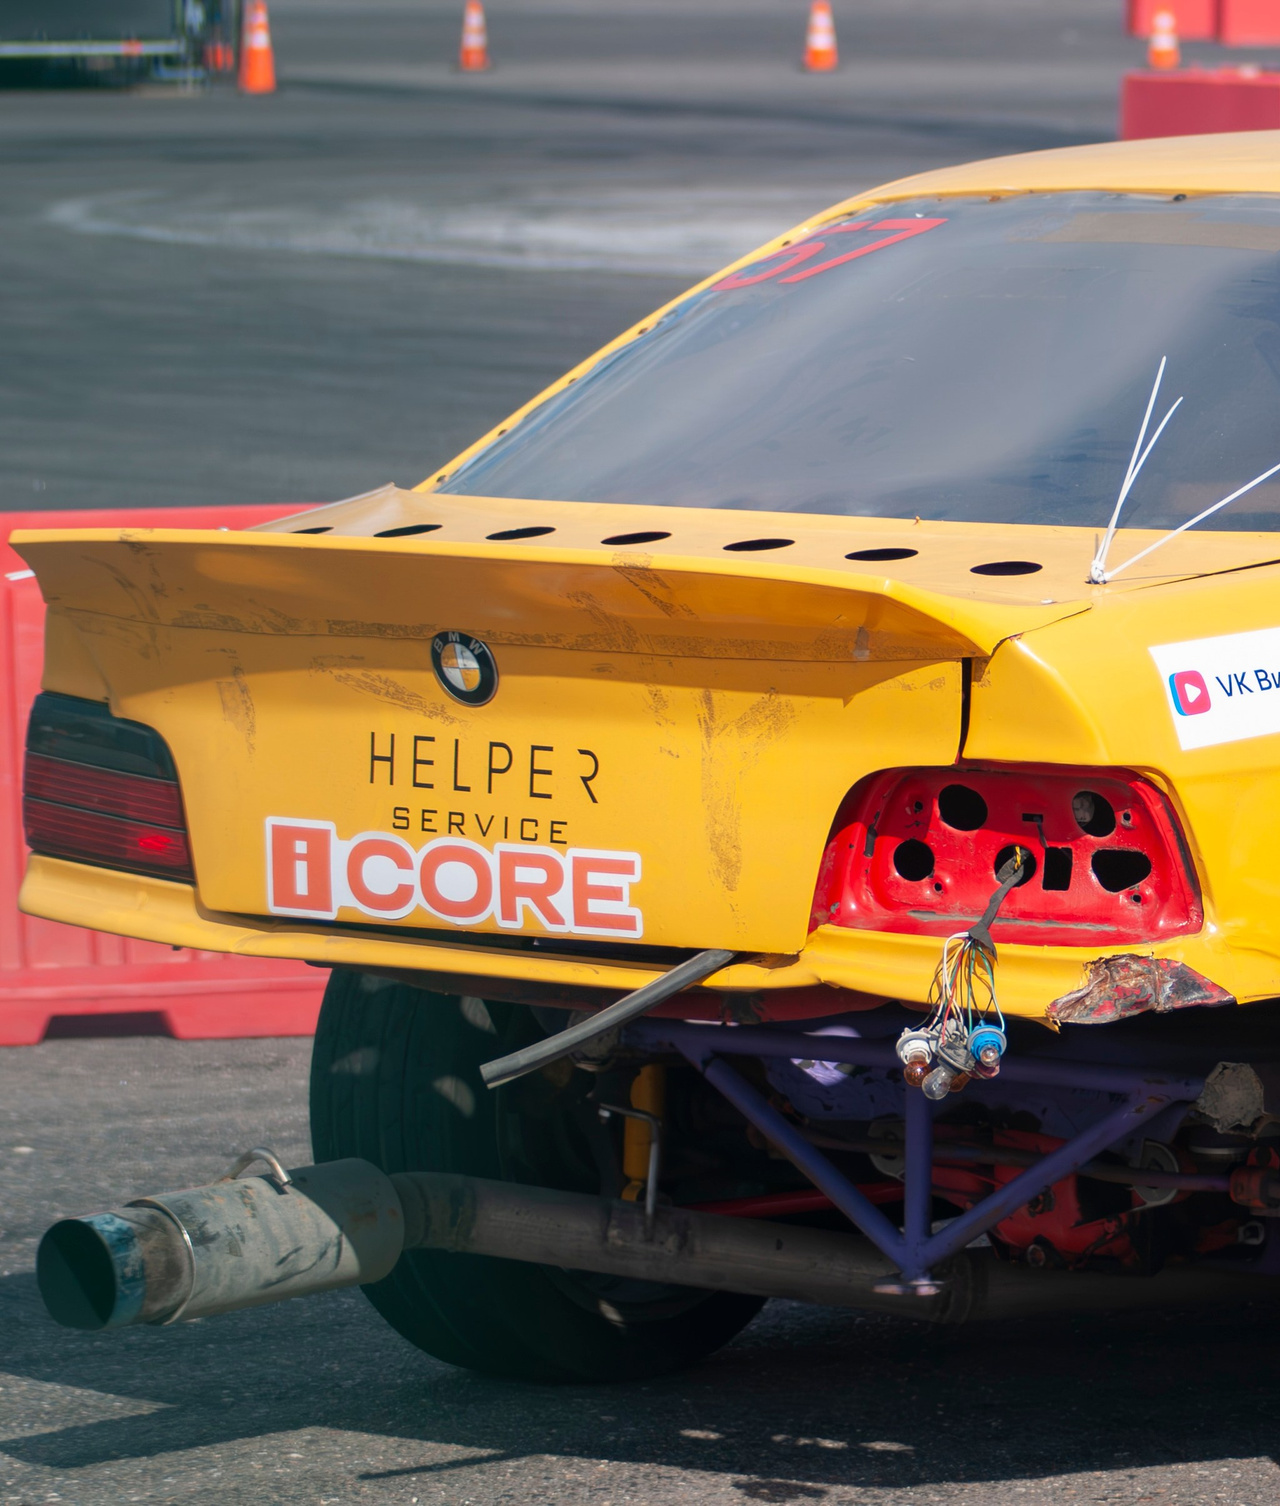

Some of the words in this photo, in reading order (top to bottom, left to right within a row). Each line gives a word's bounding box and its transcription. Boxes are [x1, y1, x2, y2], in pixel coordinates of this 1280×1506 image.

[433, 631, 484, 655] BMW
[1215, 671, 1254, 697] VK
[369, 731, 600, 804] HELPER
[392, 806, 569, 845] SERVICE
